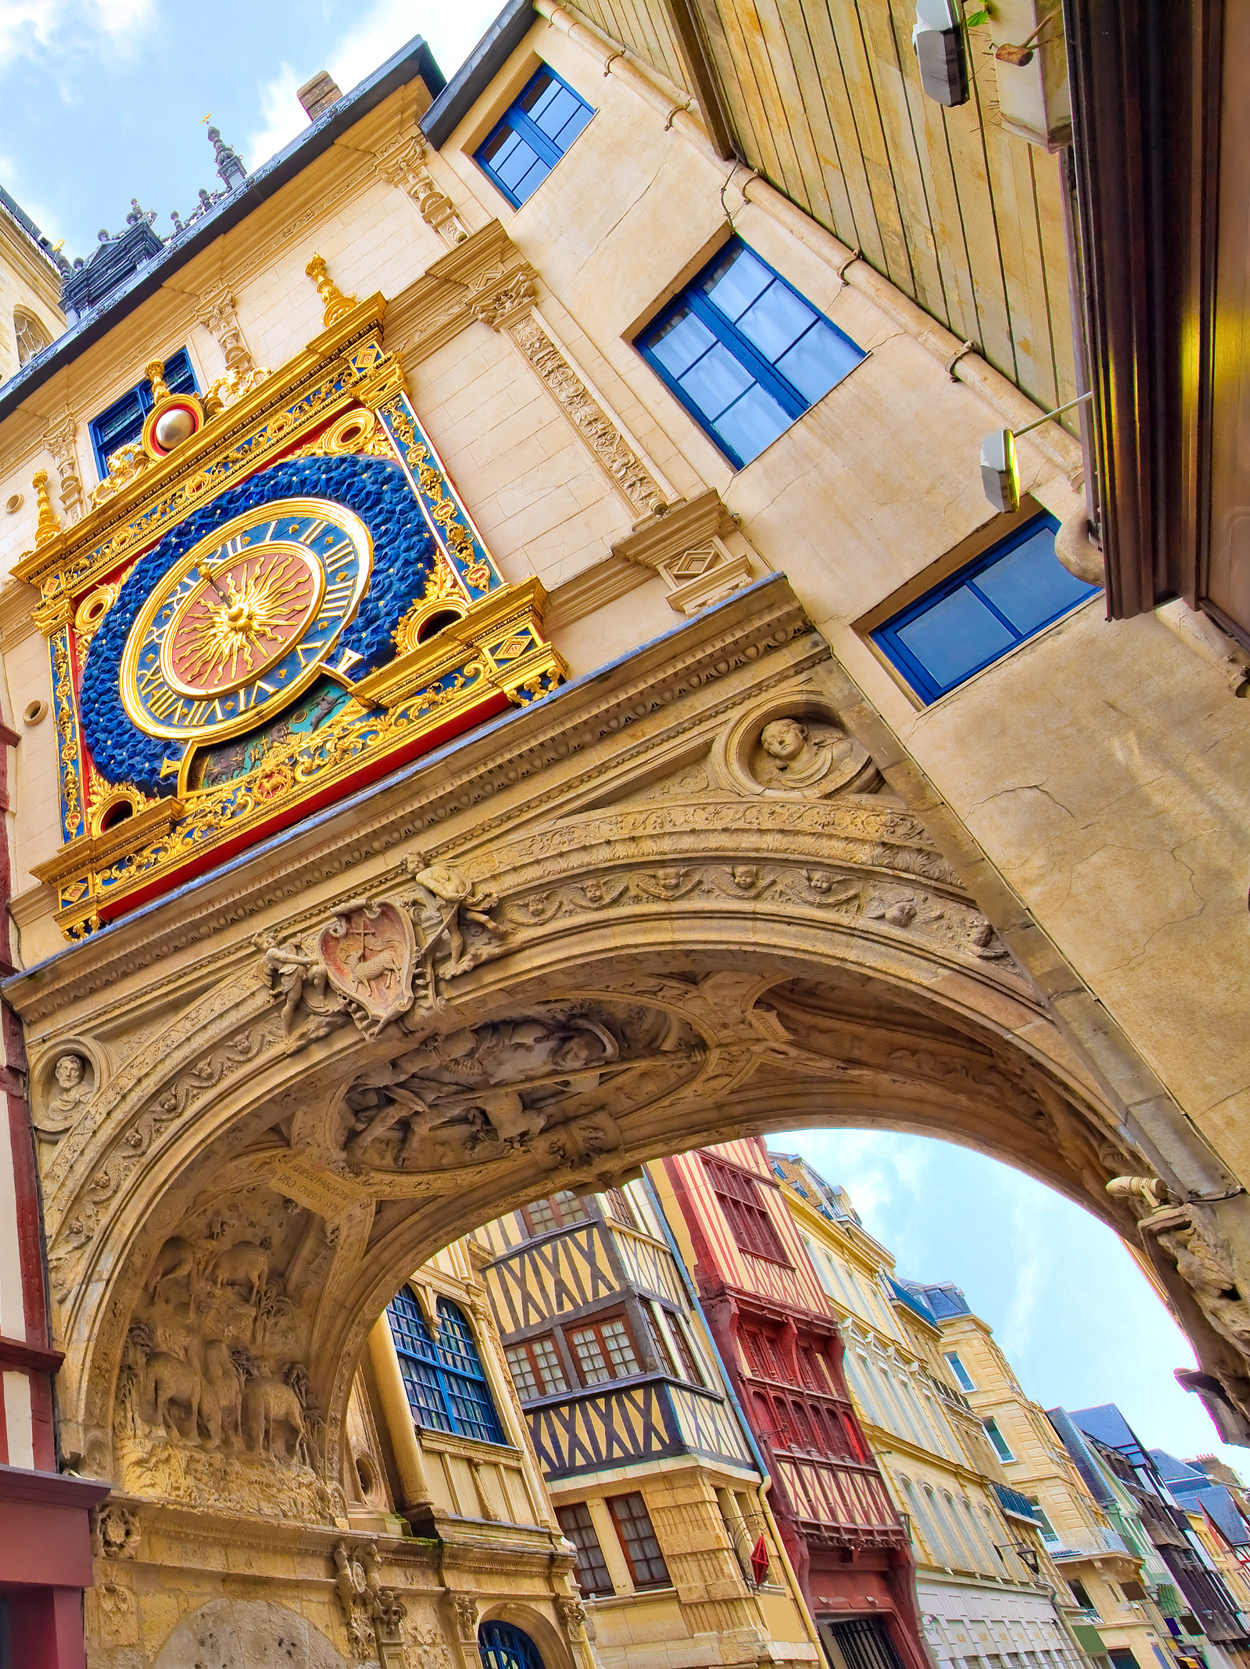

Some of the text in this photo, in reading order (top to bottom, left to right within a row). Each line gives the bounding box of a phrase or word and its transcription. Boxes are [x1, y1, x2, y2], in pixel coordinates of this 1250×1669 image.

[263, 520, 278, 543] I
[298, 519, 329, 545] II
[323, 538, 354, 574] III
[161, 576, 197, 611] XI
[316, 578, 355, 620] IIII
[141, 623, 170, 648] X
[296, 640, 326, 668] V
[146, 685, 185, 726] VIII
[237, 680, 279, 712] VI
[182, 698, 226, 727] VII
